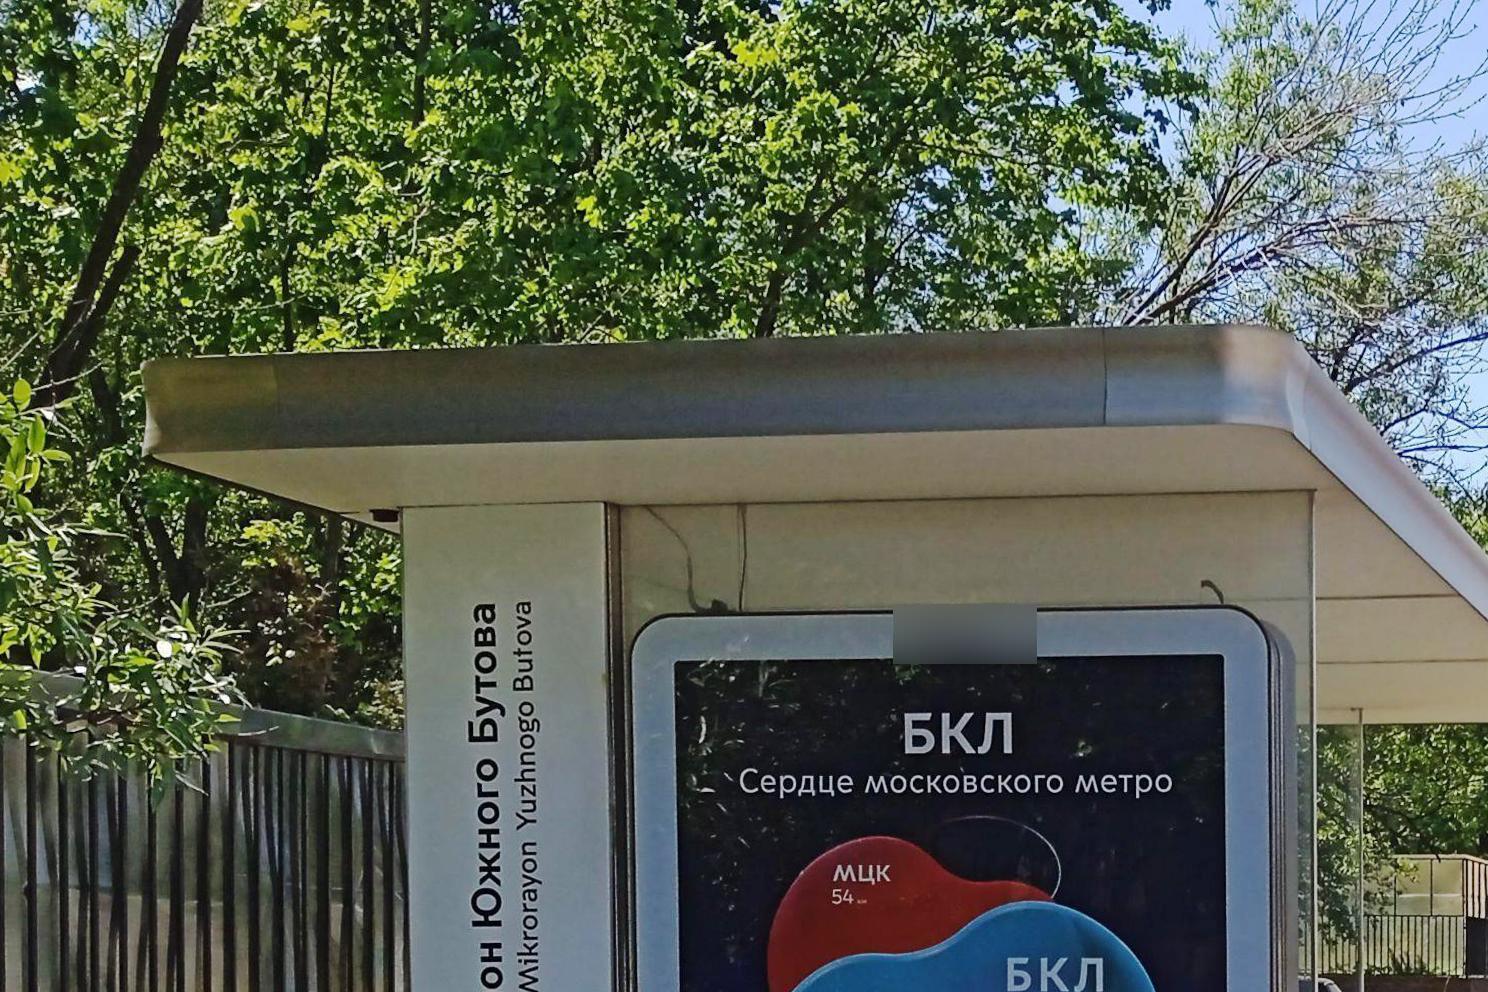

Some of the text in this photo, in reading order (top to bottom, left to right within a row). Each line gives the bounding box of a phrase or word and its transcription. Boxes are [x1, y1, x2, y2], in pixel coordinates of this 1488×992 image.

[512, 600, 535, 692] Butova
[467, 603, 507, 743] Бутова
[904, 712, 1014, 754] БКЛ
[513, 700, 542, 832] Yuzhnogo
[739, 768, 1174, 799] Сердце московского метро
[470, 758, 503, 928] Южного
[832, 864, 892, 886] МЦК
[831, 888, 855, 905] 54
[1006, 957, 1105, 992] БКЛ
